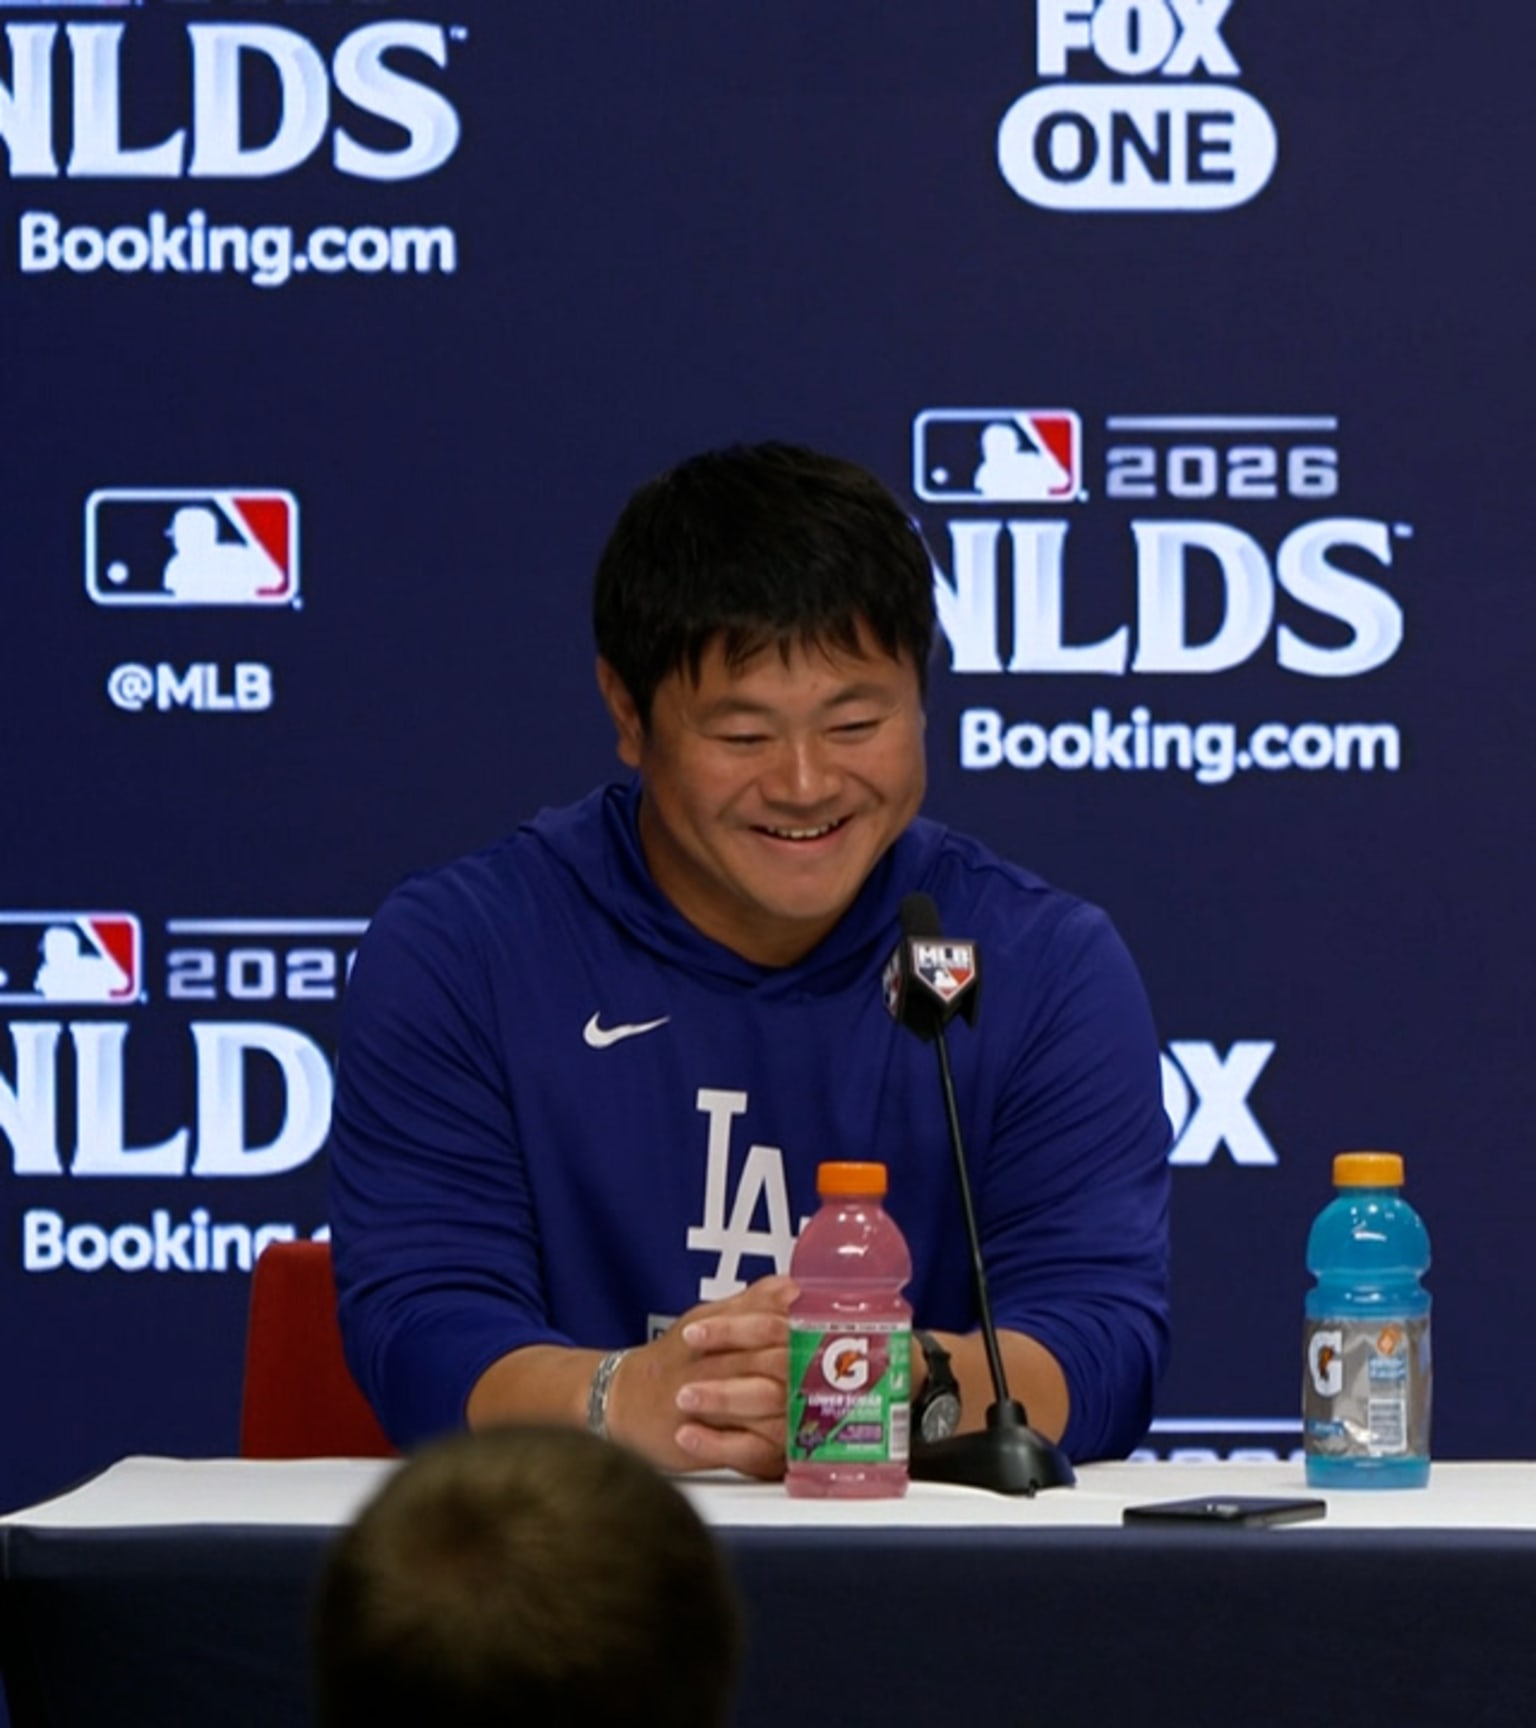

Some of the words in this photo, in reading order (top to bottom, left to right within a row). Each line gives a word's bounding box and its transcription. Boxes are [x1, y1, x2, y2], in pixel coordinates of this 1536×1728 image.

[1037, 0, 1241, 76] FOX
[1033, 111, 1235, 184] ONE
[20, 209, 456, 287] Booking.com
[1106, 447, 1338, 498] 2026
[107, 663, 273, 711] @MLB
[961, 706, 1400, 784] Booking.com
[168, 949, 357, 999] 202
[687, 1089, 809, 1301] LA
[822, 1338, 868, 1391] G
[1308, 1330, 1343, 1397] G
